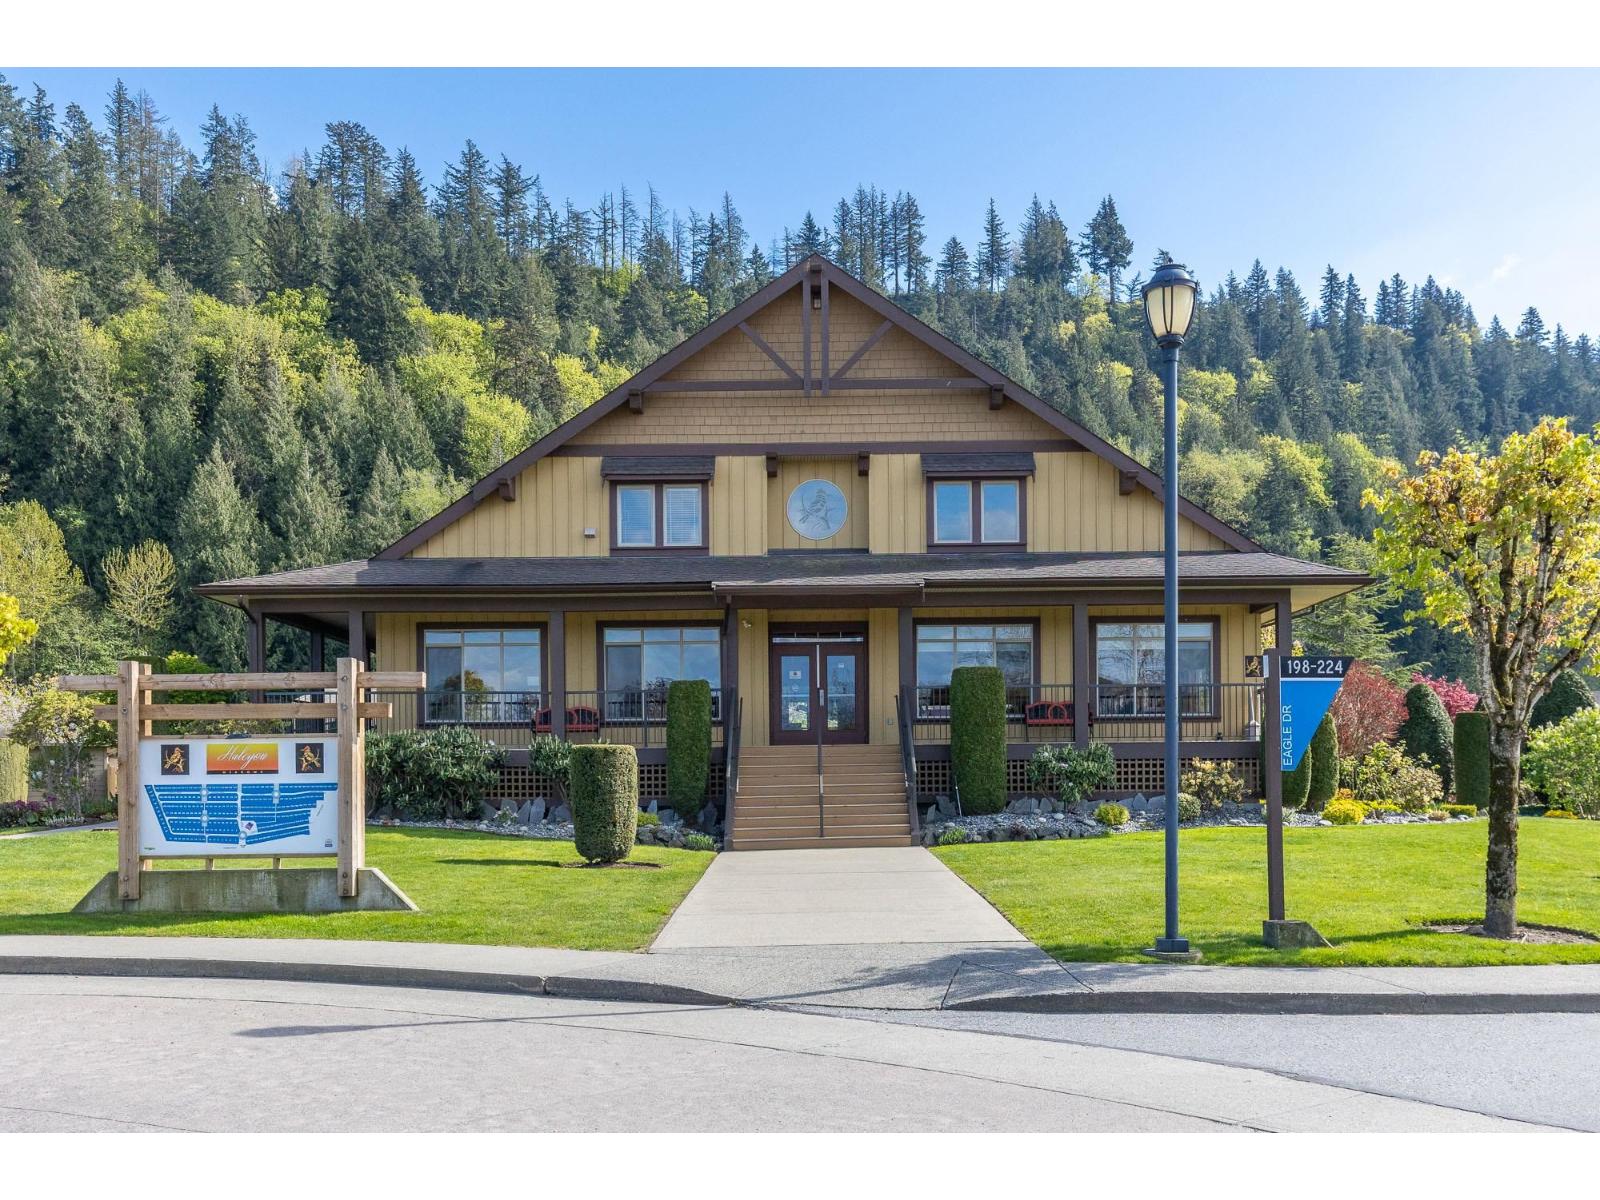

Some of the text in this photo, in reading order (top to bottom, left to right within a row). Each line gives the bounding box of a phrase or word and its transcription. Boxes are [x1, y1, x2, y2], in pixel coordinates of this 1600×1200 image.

[1287, 660, 1343, 674] 198-224
[1283, 704, 1293, 766] EAGLE DR
